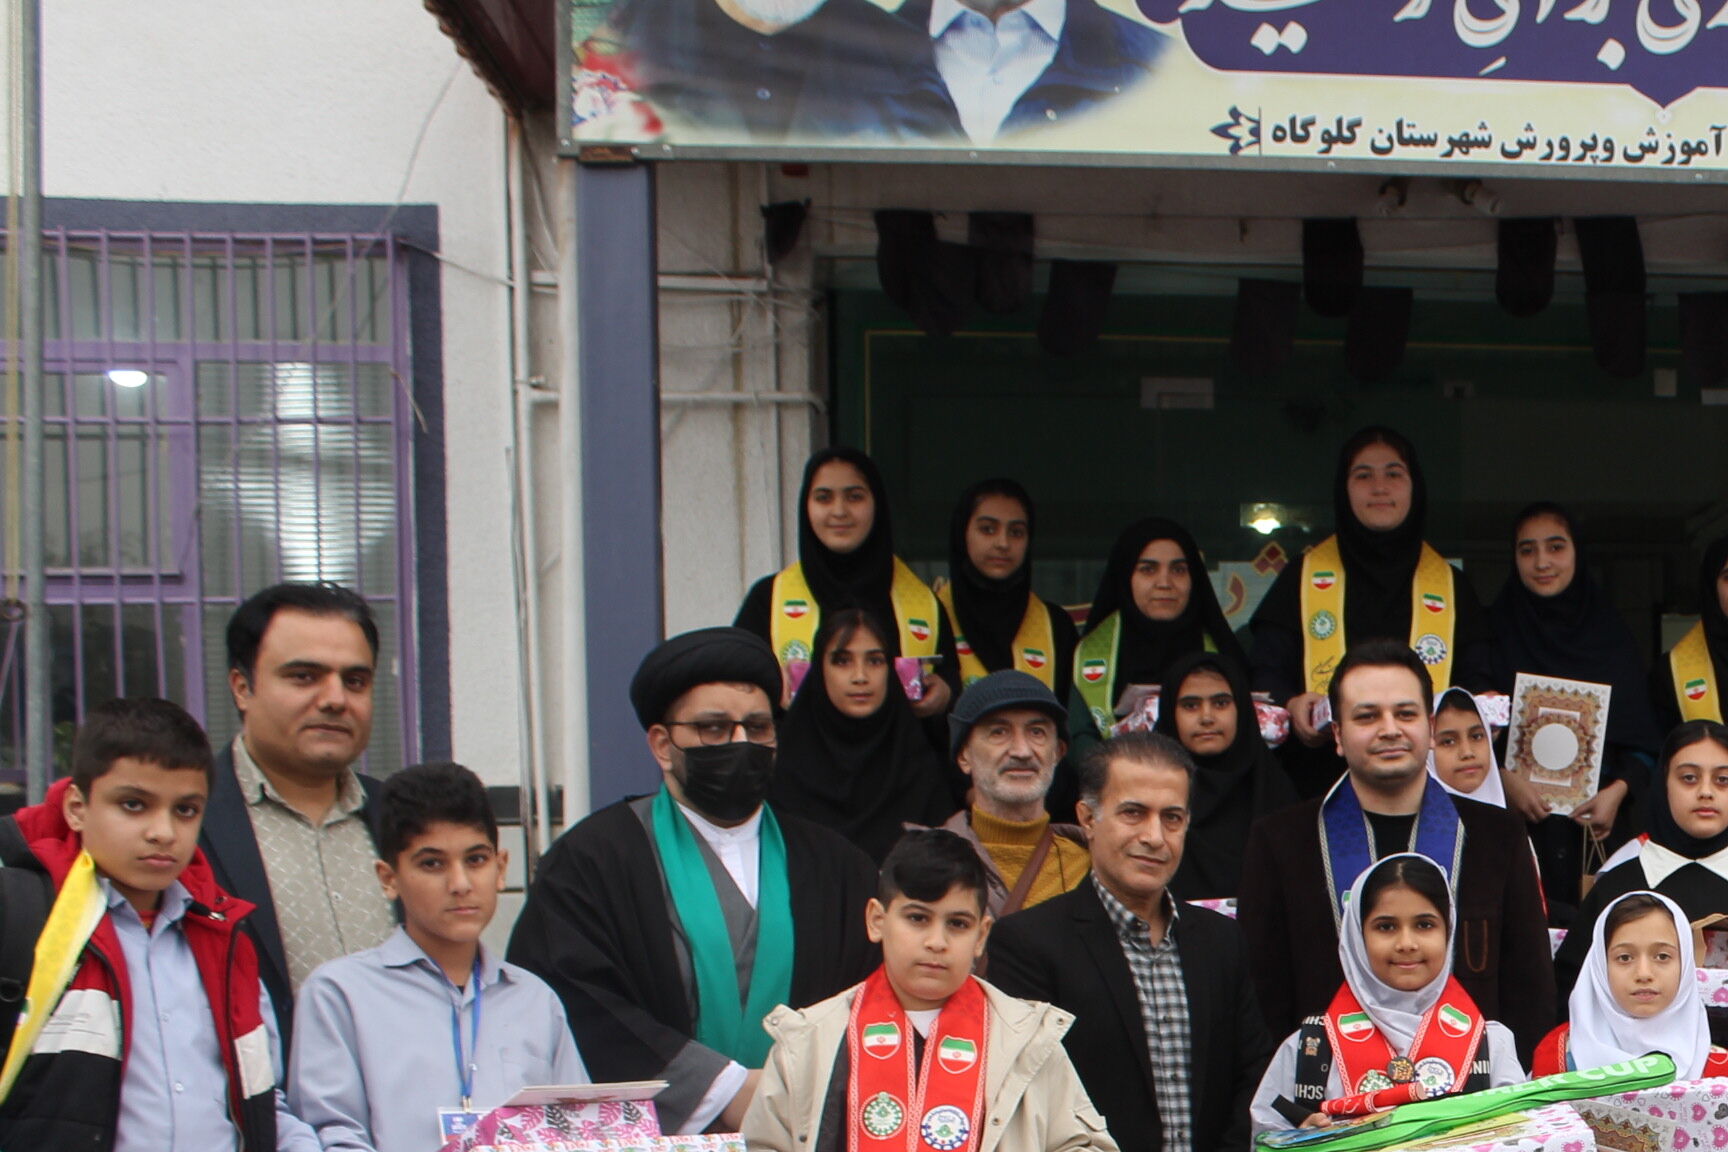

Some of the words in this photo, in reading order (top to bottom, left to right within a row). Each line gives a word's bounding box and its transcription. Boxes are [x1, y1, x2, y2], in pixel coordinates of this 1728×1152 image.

[1370, 117, 1493, 158] شهرستان
[1622, 125, 1727, 166] آموزش
[1578, 1055, 1660, 1082] CUP
